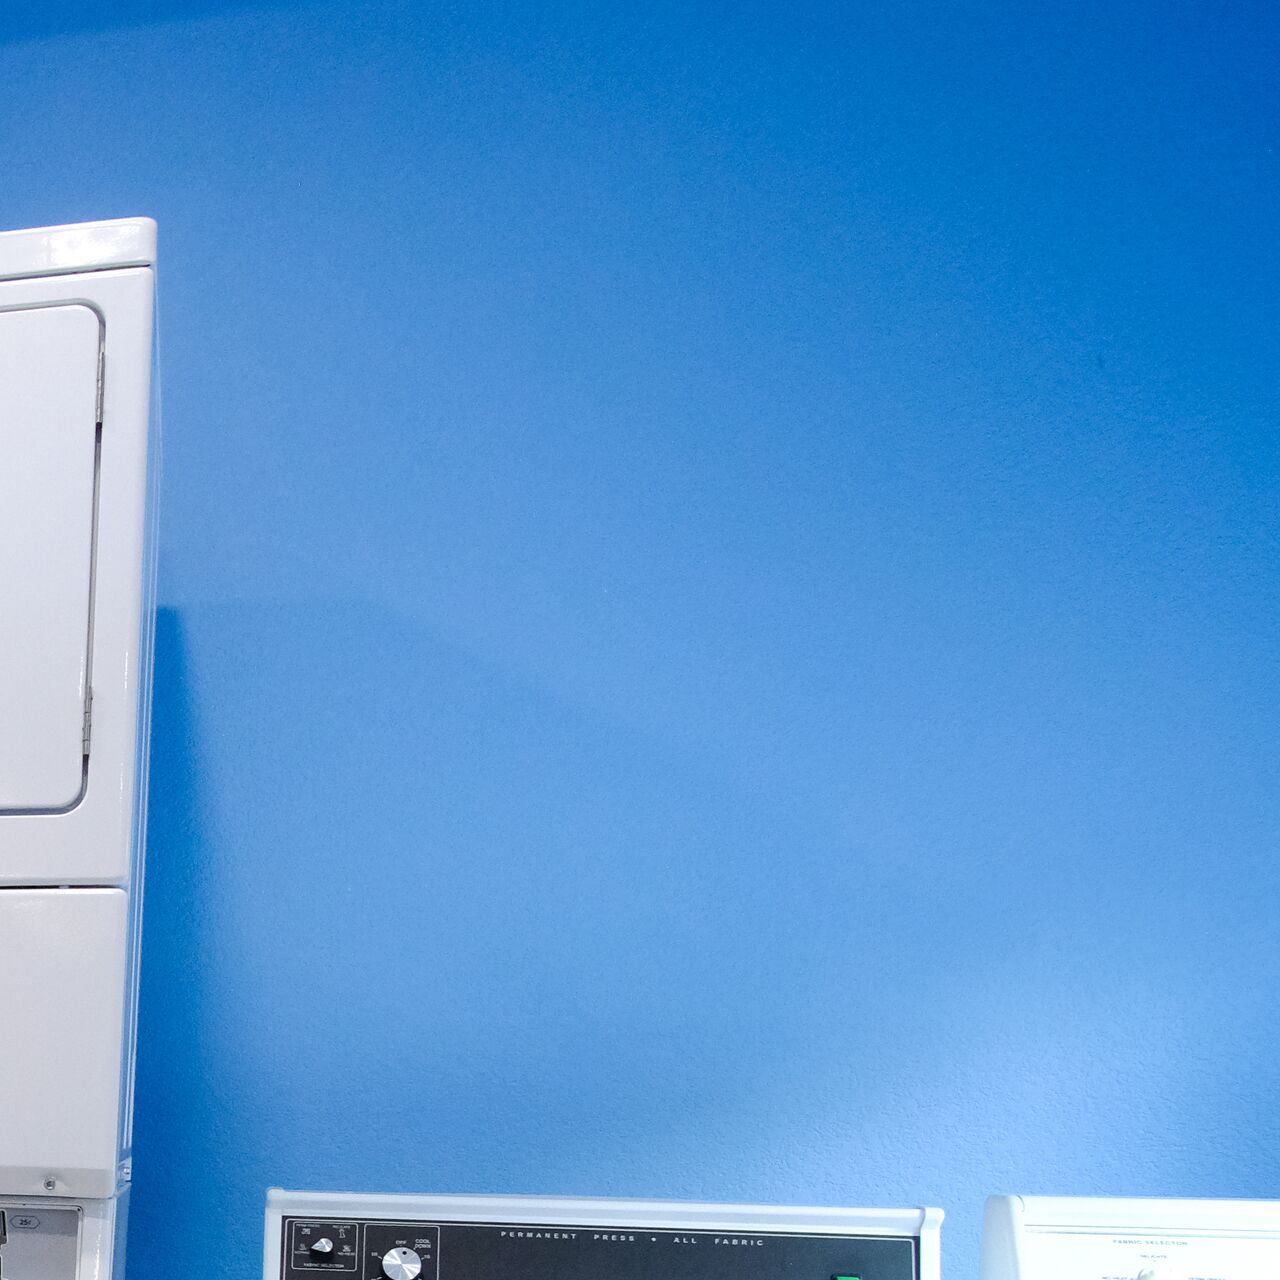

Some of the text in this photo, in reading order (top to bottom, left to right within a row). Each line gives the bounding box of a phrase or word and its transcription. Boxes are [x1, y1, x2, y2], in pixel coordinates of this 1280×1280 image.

[500, 1231, 578, 1239] PERMANENT
[593, 1234, 635, 1242] PRESS
[714, 1238, 765, 1246] FABRIC
